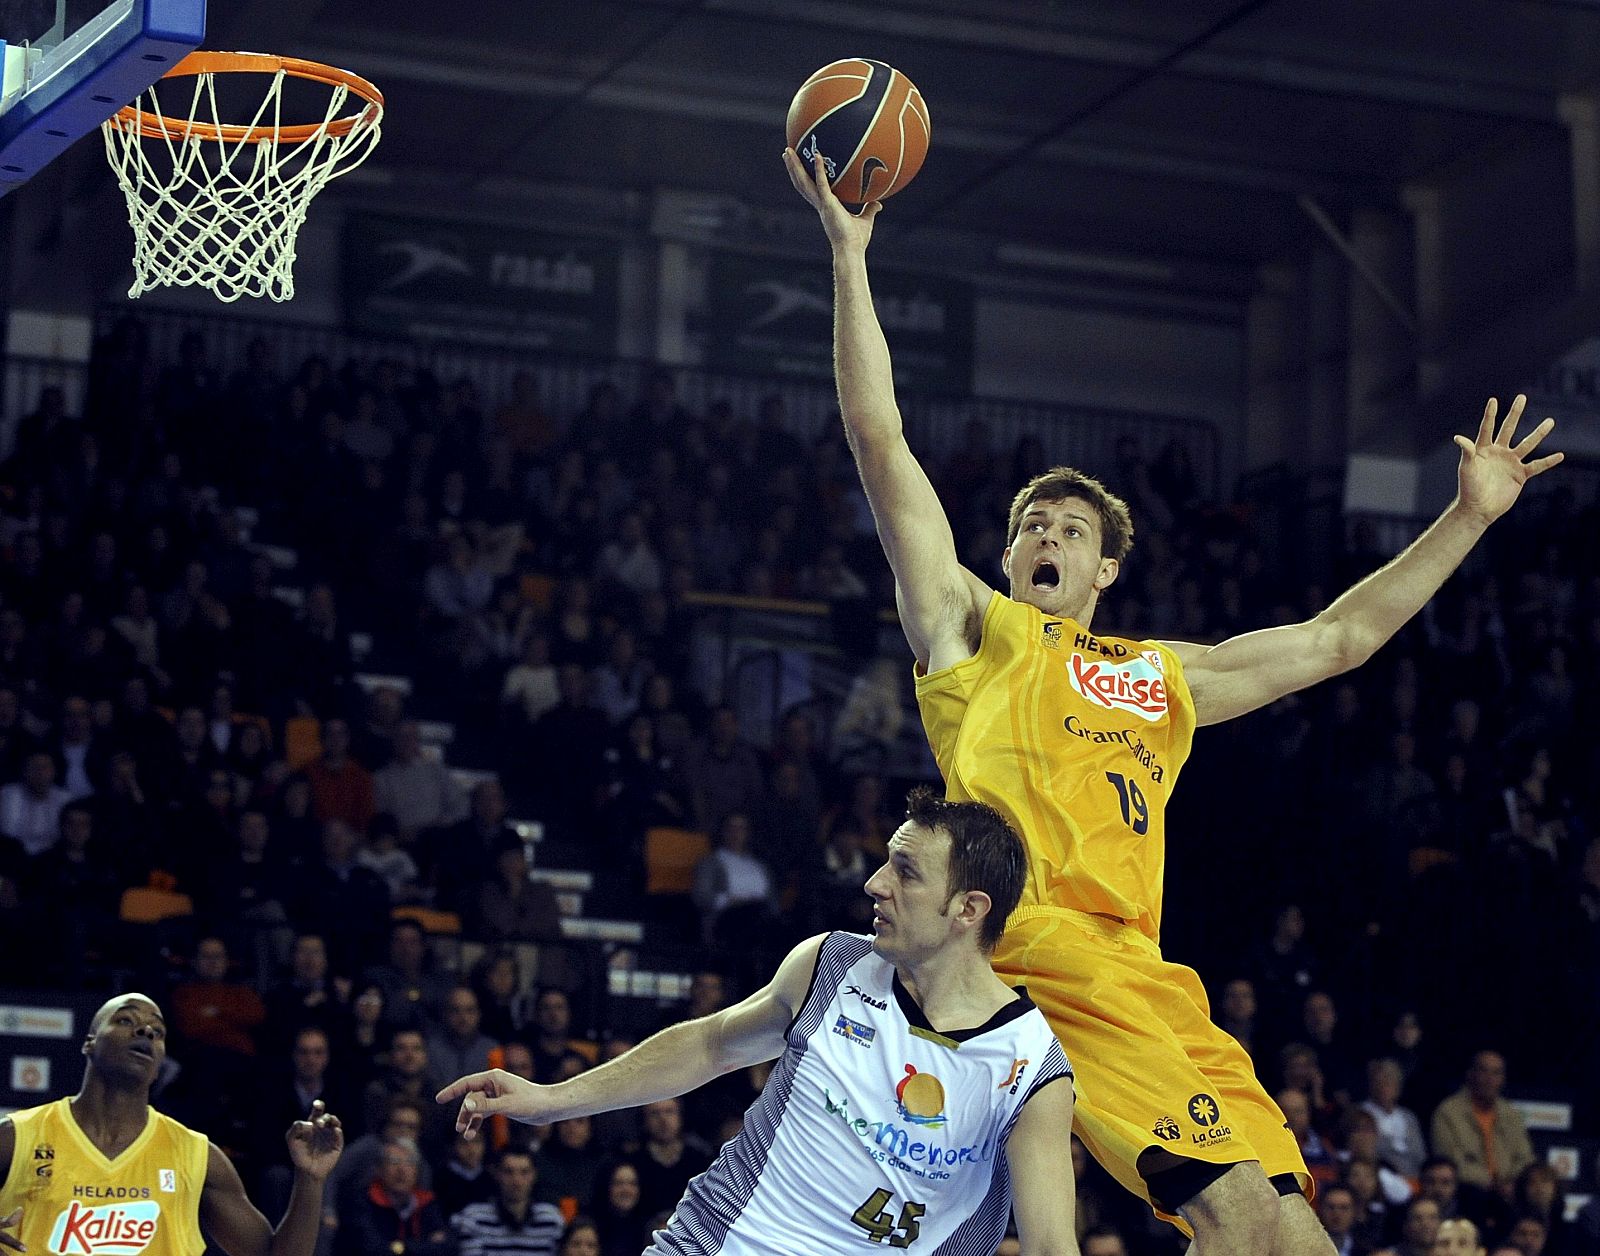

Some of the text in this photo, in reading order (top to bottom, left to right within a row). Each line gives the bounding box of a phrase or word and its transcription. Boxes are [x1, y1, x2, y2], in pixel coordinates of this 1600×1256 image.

[1073, 655, 1166, 708] Kalise
[1105, 771, 1149, 836] 19
[1009, 1065, 1025, 1095] ACB
[1192, 1125, 1232, 1144] La Caja
[73, 1185, 150, 1198] HELADOS
[915, 1168, 926, 1178] al
[59, 1202, 155, 1253] Kalise
[851, 1187, 926, 1249] 45
